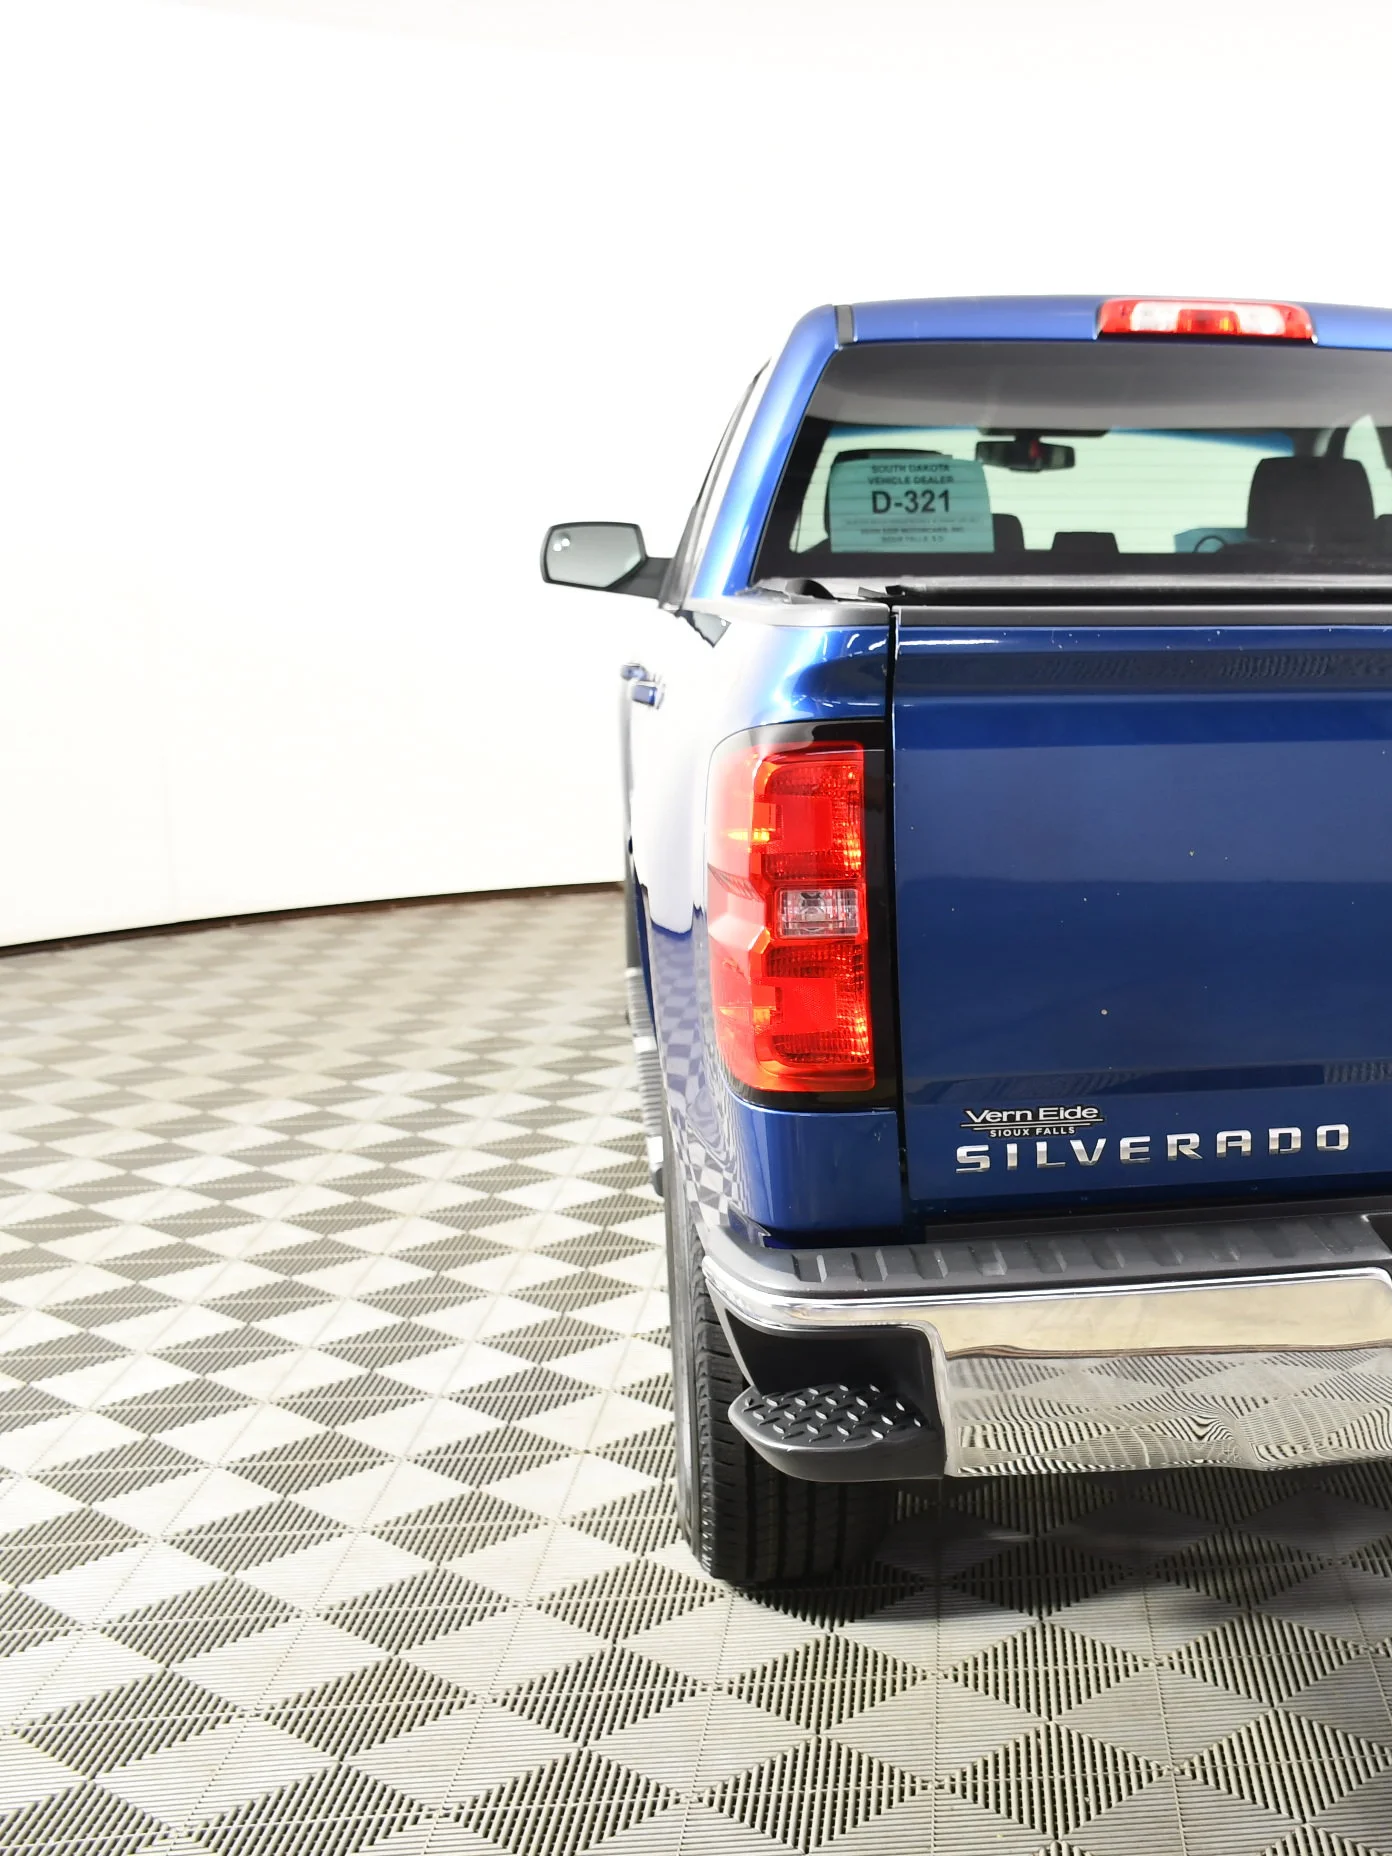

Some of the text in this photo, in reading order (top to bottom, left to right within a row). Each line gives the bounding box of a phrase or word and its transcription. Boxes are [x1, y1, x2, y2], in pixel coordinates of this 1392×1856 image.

[872, 463, 950, 474] SOUTH DAKOTA
[868, 475, 955, 485] VEHICLE DEALER
[872, 488, 950, 514] D-321
[965, 1105, 1099, 1123] Vern Eide
[990, 1126, 1075, 1138] SIOUX FALLS
[955, 1123, 1352, 1174] SILVERADO
